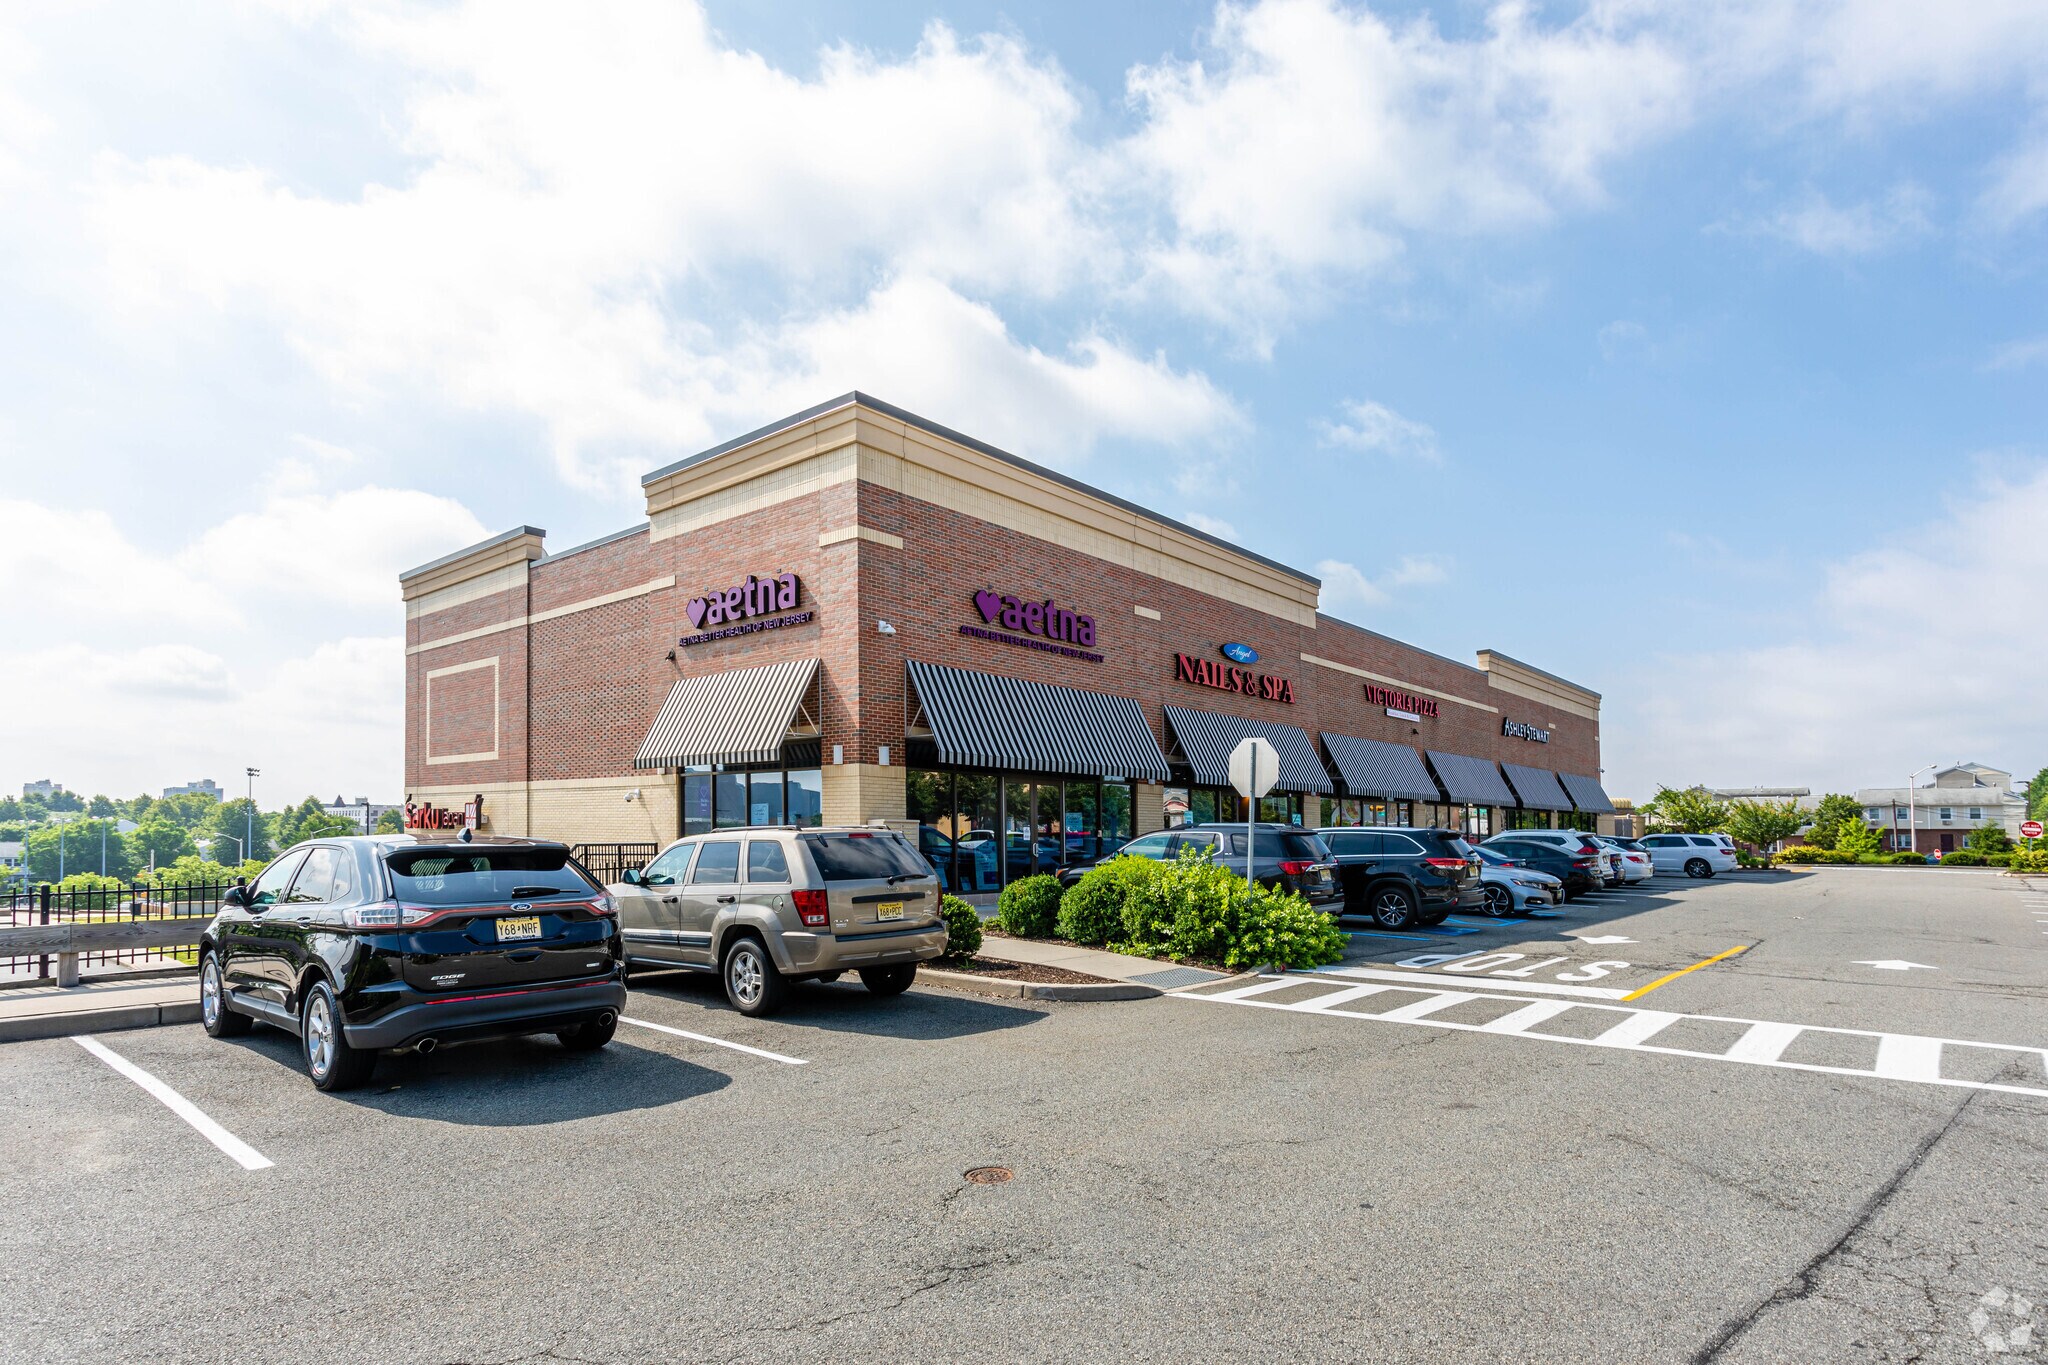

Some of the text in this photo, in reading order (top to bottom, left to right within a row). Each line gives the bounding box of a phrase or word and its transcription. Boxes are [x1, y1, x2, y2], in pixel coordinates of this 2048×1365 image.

[707, 573, 798, 625] aetna
[679, 611, 811, 647] AETNA BETTER HEALTH OF NEW JERSEY
[1001, 595, 1096, 646] aetna
[960, 625, 1105, 663] AETNA BETTER HEALTH OF NEW JERSEY
[1230, 647, 1251, 660] Angel
[1176, 652, 1296, 704] NAILS & SPA
[1365, 684, 1413, 713] VICTORIA
[1413, 696, 1441, 718] PIZZA
[1503, 717, 1550, 743] ASHLEY STEWART
[404, 801, 440, 830] Sarku
[1395, 950, 1631, 981] STOP
